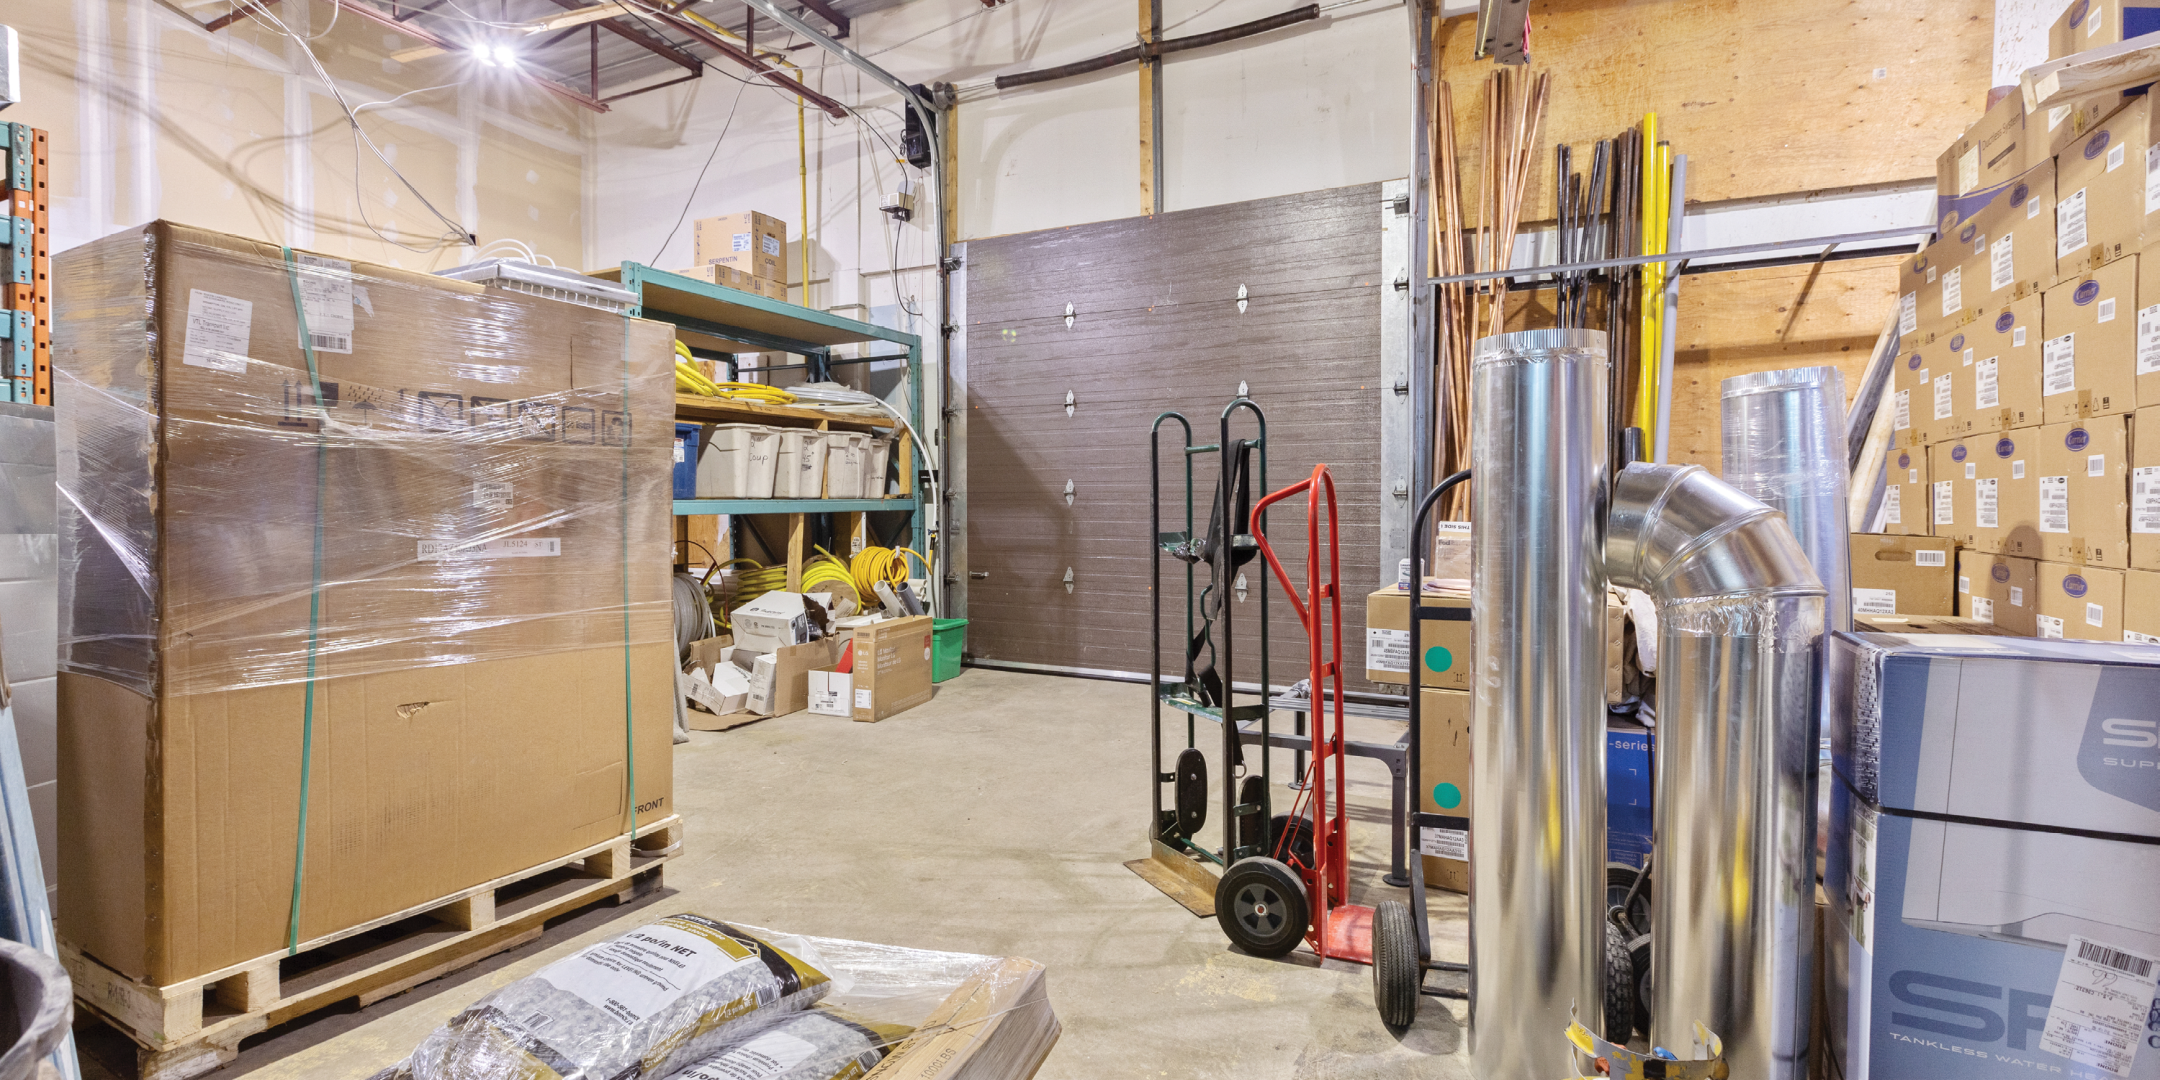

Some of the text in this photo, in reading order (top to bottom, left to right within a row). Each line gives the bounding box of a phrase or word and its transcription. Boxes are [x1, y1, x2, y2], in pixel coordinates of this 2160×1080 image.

[709, 255, 738, 265] SERPENTIN
[764, 257, 777, 267] COIL
[2075, 286, 2097, 300] Carrier
[192, 318, 202, 326] VTL
[2067, 434, 2087, 446] Carrier
[2064, 579, 2086, 592] Carrier
[2102, 718, 2160, 748] S
[2103, 757, 2160, 768] SUP
[640, 936, 671, 950] po/in
[670, 945, 697, 957] NET
[1889, 1032, 1989, 1059] TANKLESS
[1994, 1053, 2063, 1075] WATER
[921, 1048, 957, 1080] 1000LBS
